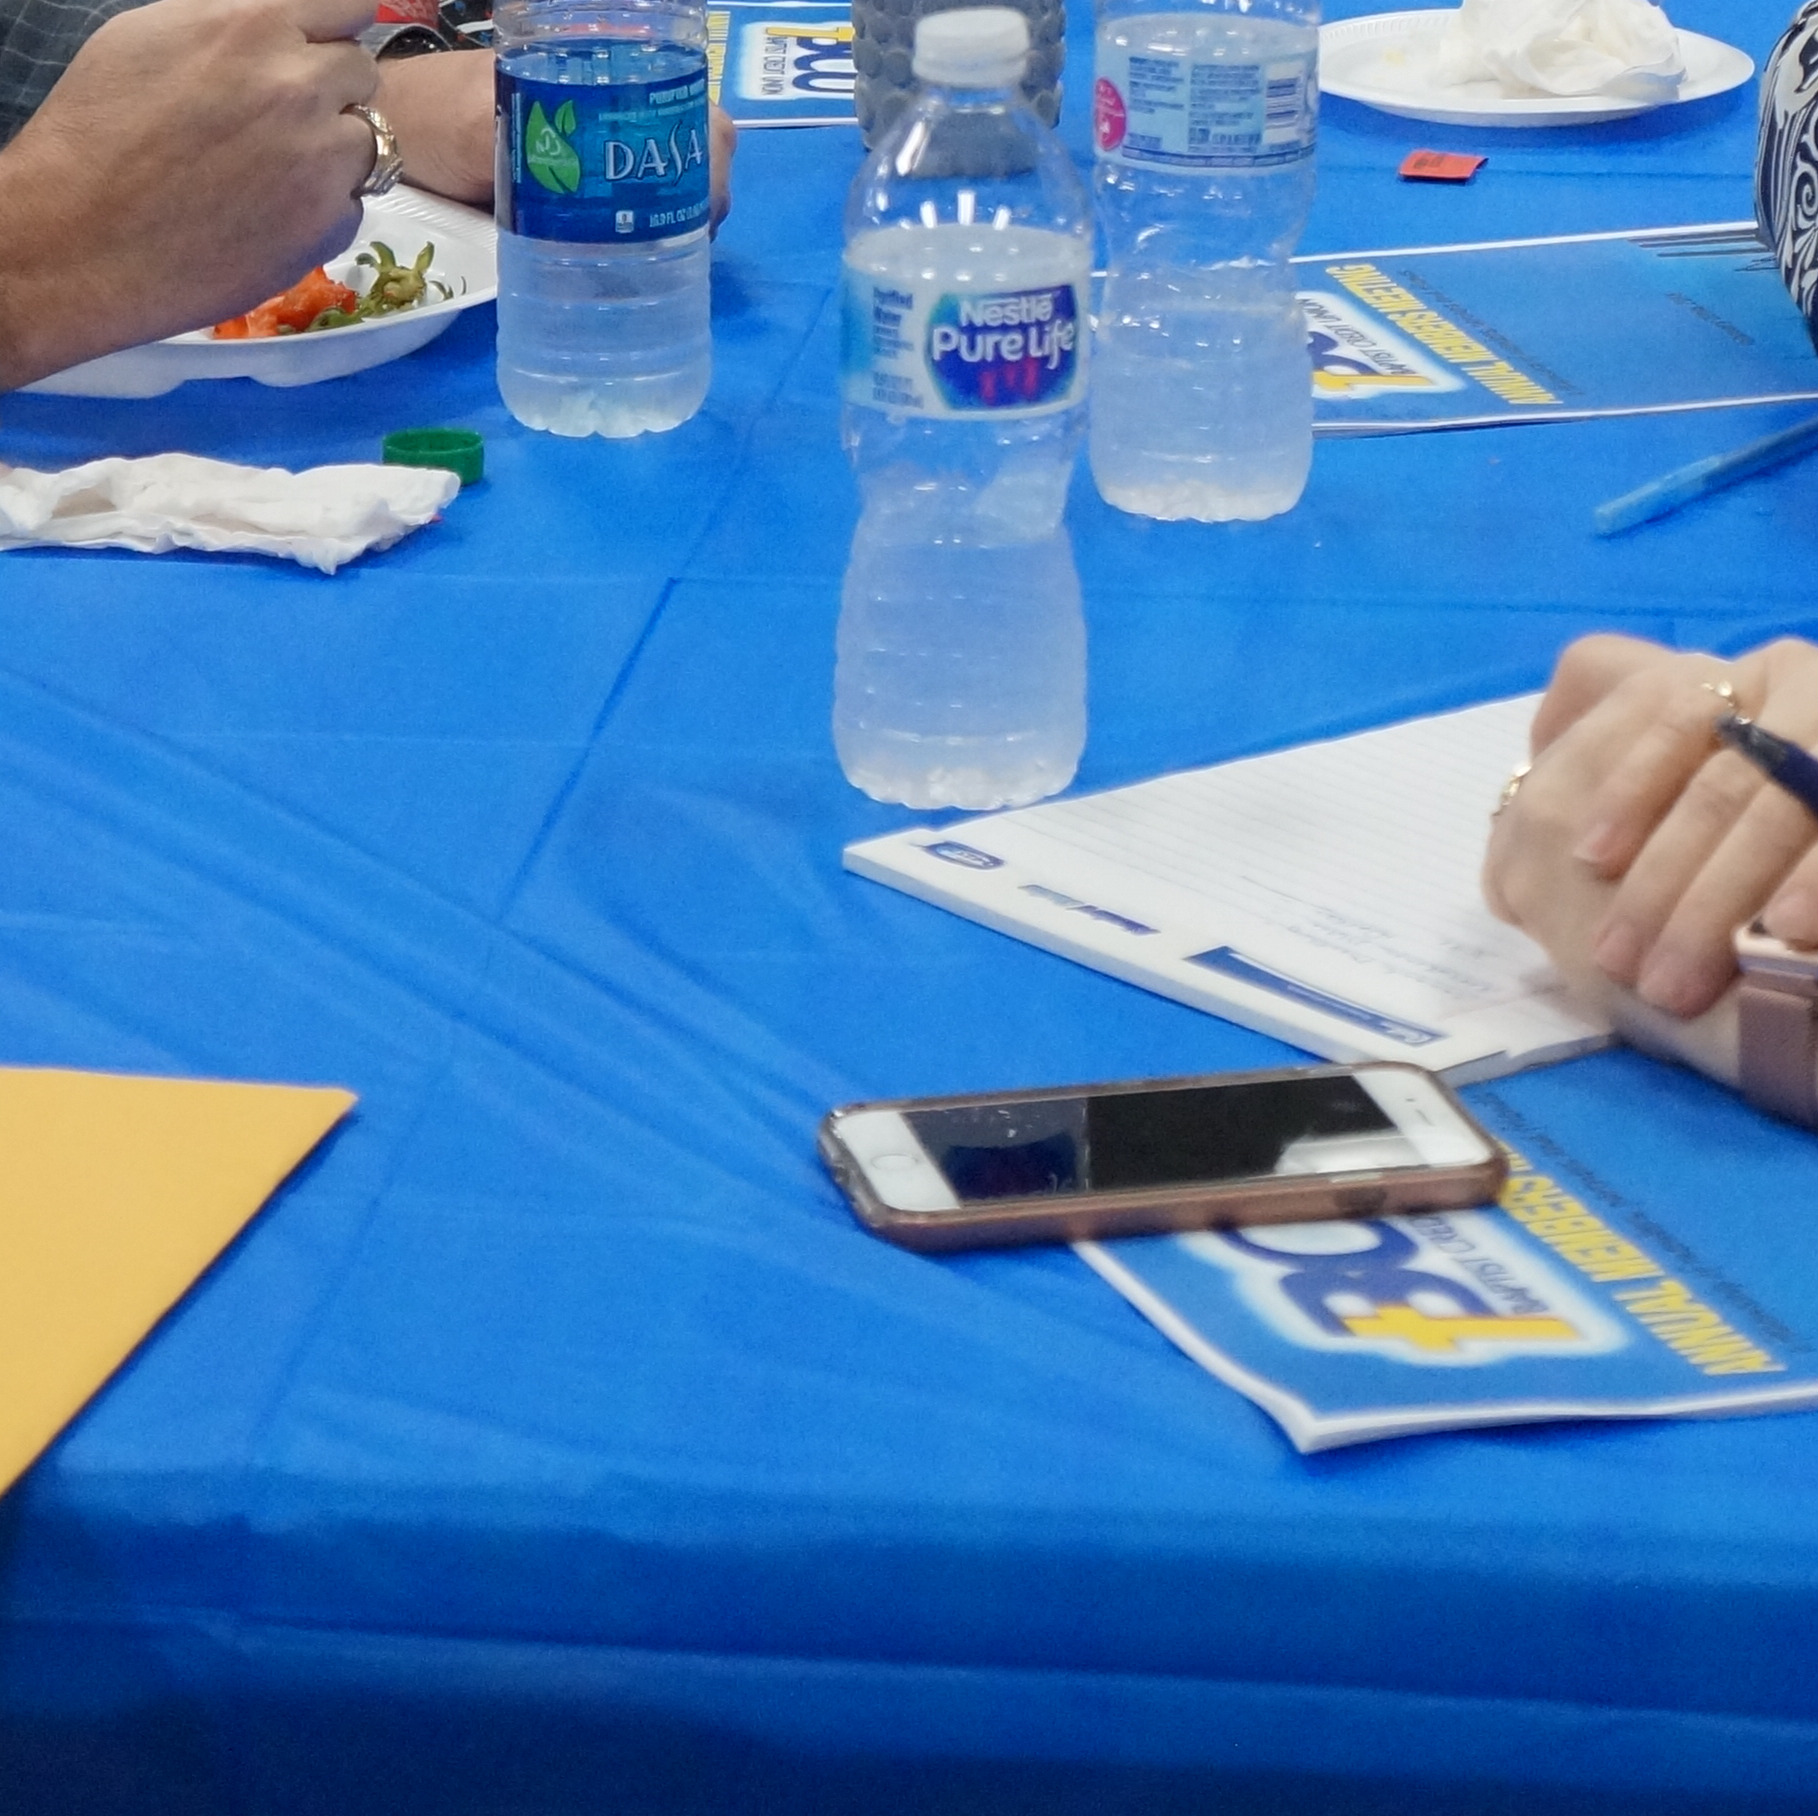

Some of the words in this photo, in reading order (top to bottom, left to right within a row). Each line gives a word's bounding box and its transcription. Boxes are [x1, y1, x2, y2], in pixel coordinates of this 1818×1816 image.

[604, 120, 704, 186] DASA
[932, 326, 1025, 363] Pure
[1028, 319, 1075, 370] Life
[1501, 1176, 1666, 1283] MEMBERS
[1614, 1280, 1789, 1376] ANNUAL
